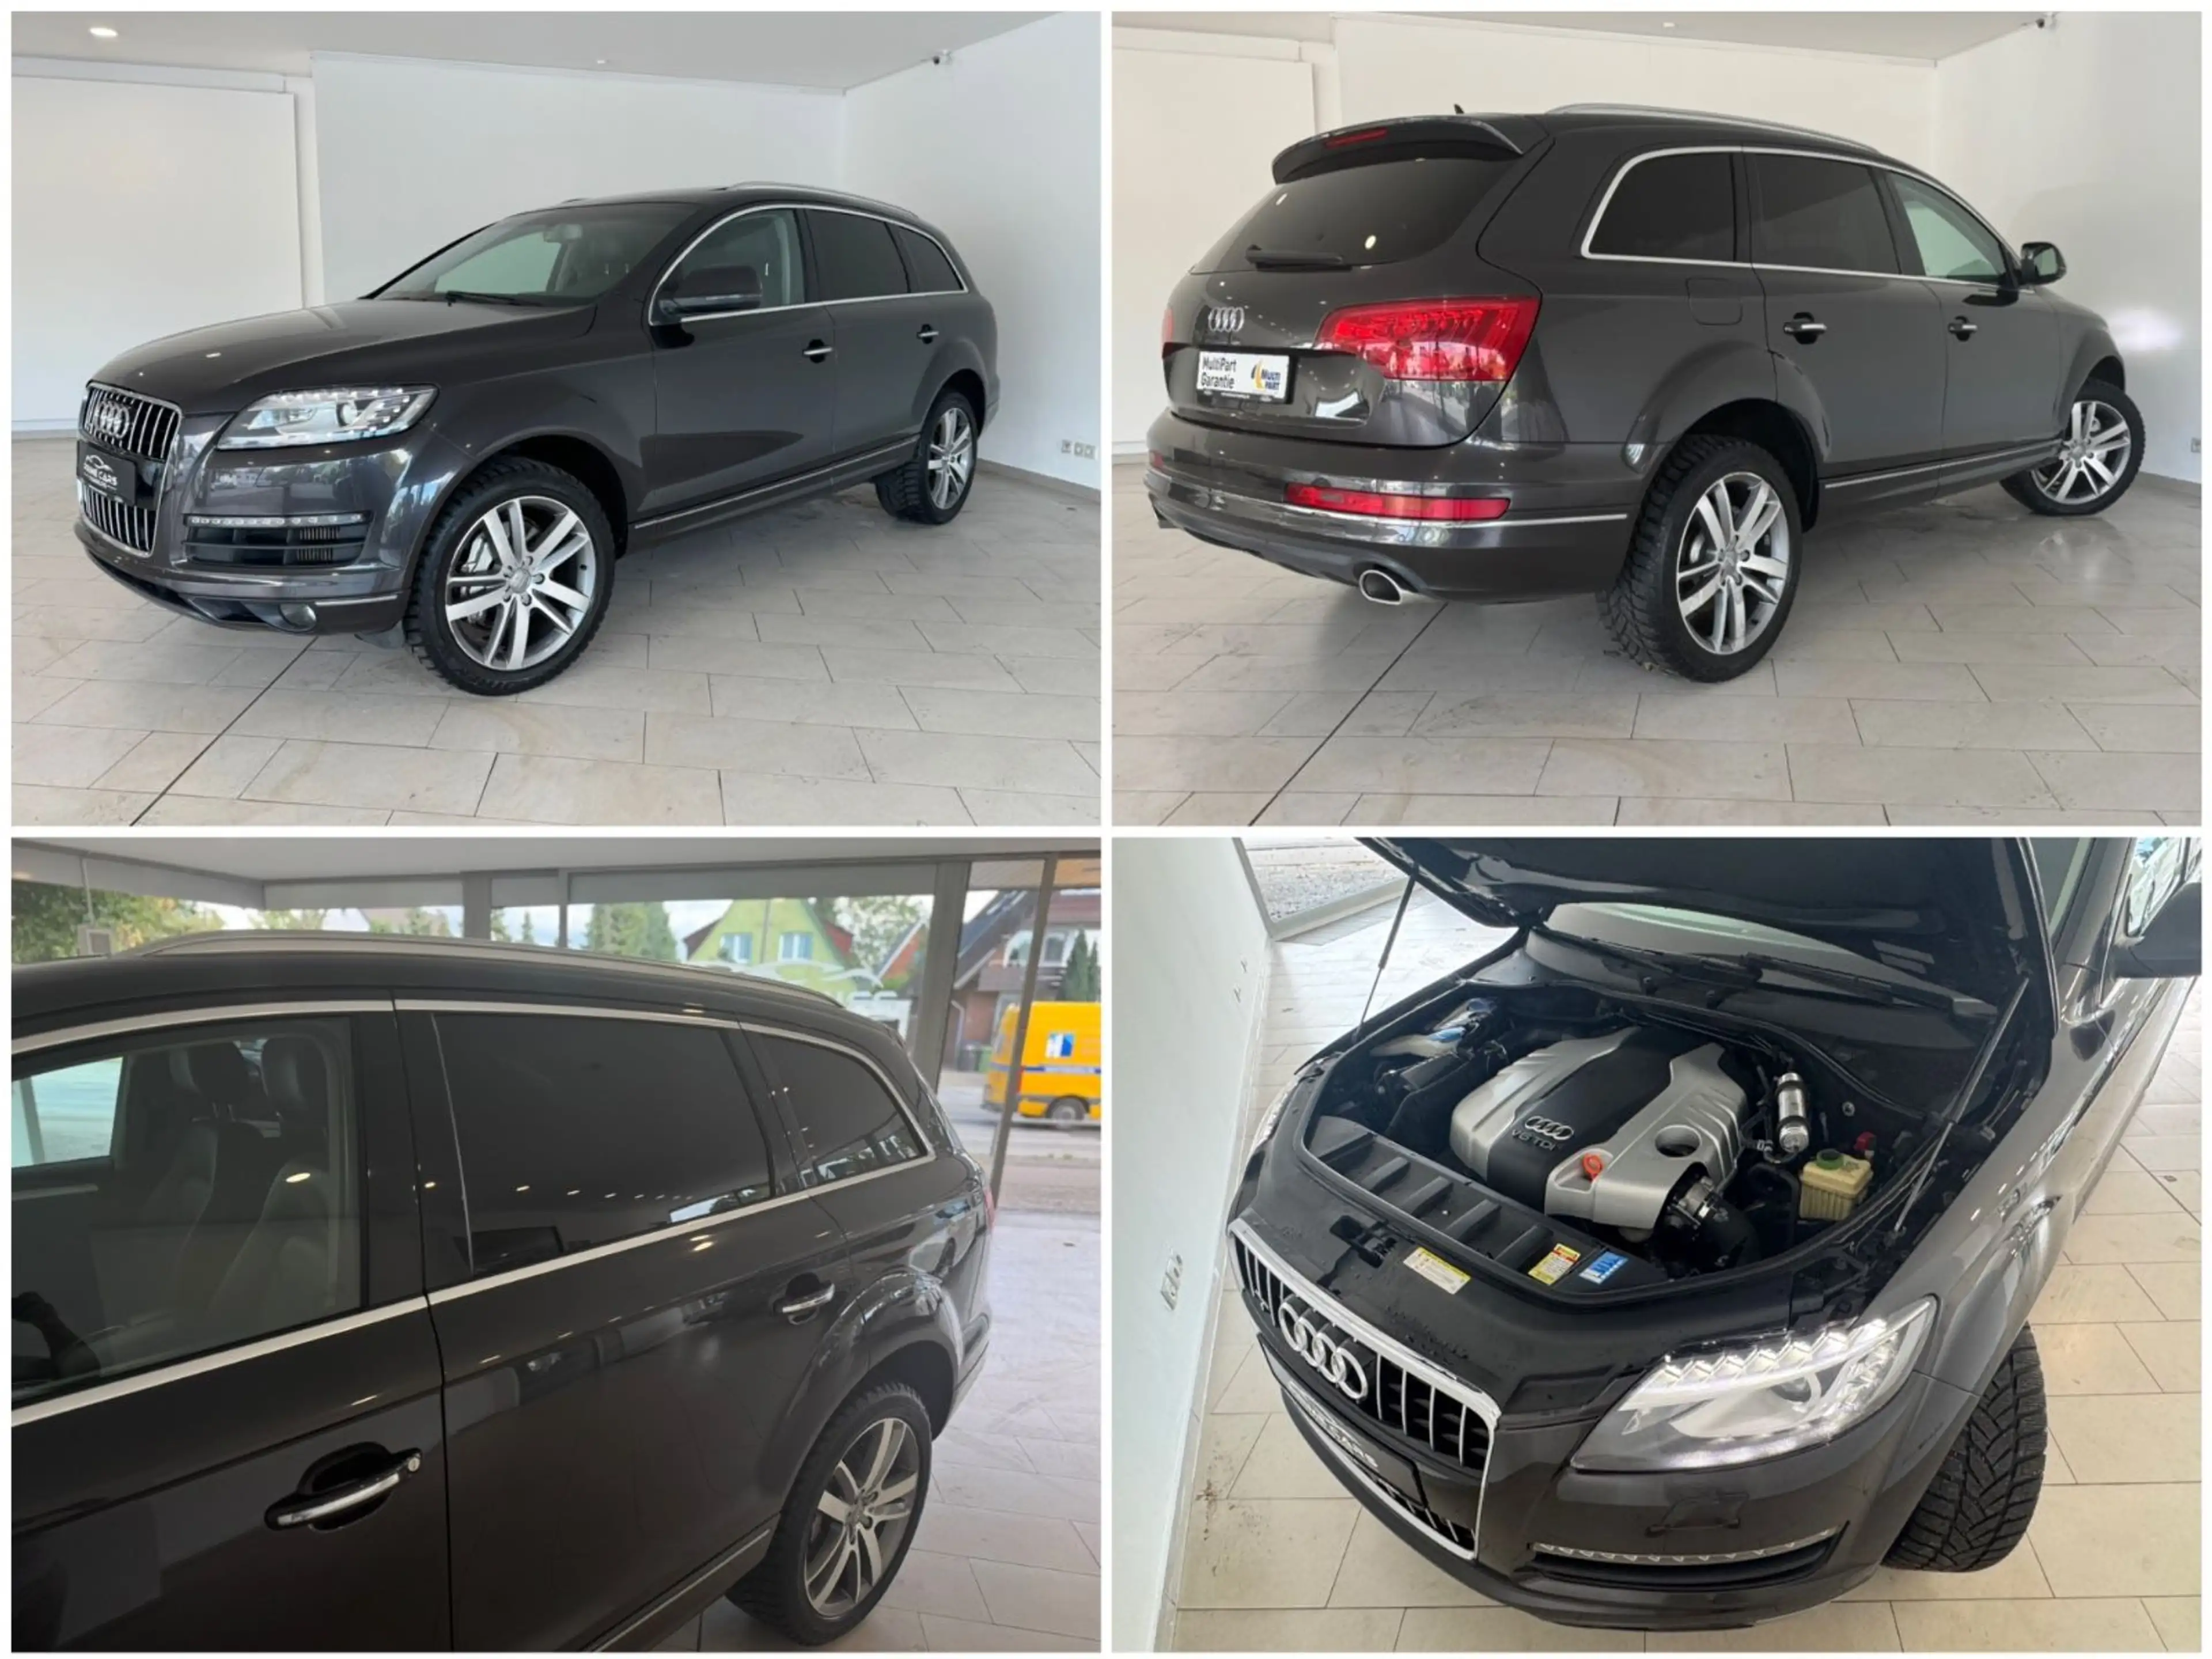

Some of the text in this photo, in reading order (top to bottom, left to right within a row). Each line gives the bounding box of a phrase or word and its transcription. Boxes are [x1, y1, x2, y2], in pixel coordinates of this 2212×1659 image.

[1203, 357, 1237, 372] MultiPart
[1200, 372, 1235, 389] Garantie
[1512, 1130, 1556, 1151] V6 TDI
